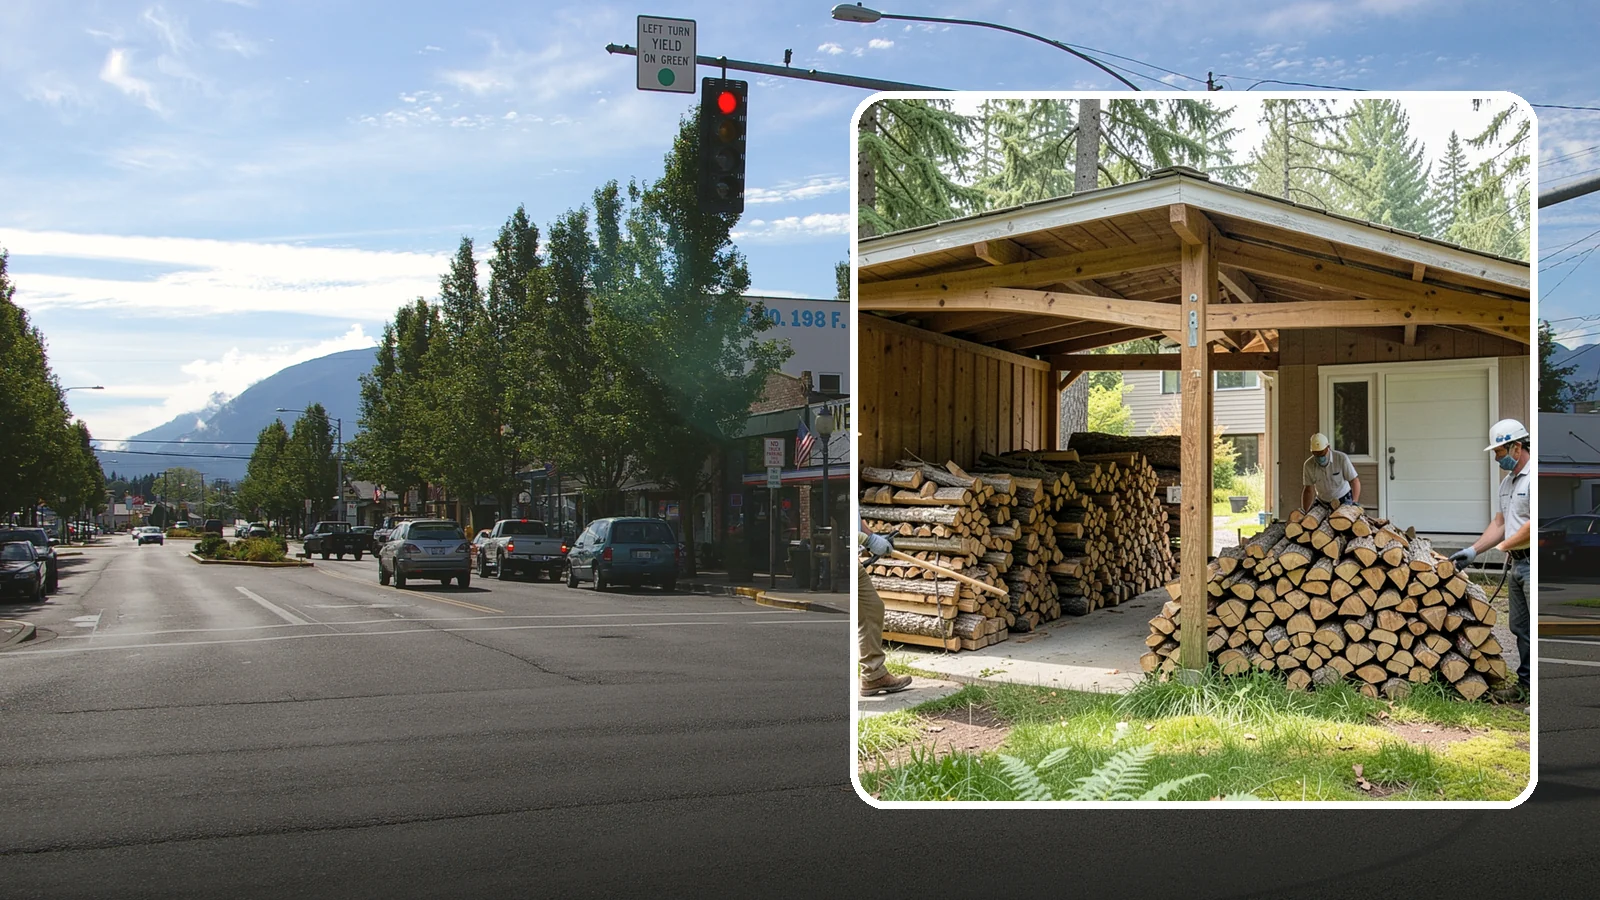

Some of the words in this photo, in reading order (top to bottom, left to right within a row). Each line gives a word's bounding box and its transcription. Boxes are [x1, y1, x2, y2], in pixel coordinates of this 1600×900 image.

[642, 23, 663, 34] LEFT
[668, 25, 690, 37] TURN
[652, 38, 682, 52] YIELD
[644, 53, 656, 64] ON
[661, 54, 690, 66] GREEN
[791, 309, 826, 328] 198
[831, 311, 846, 329] F.
